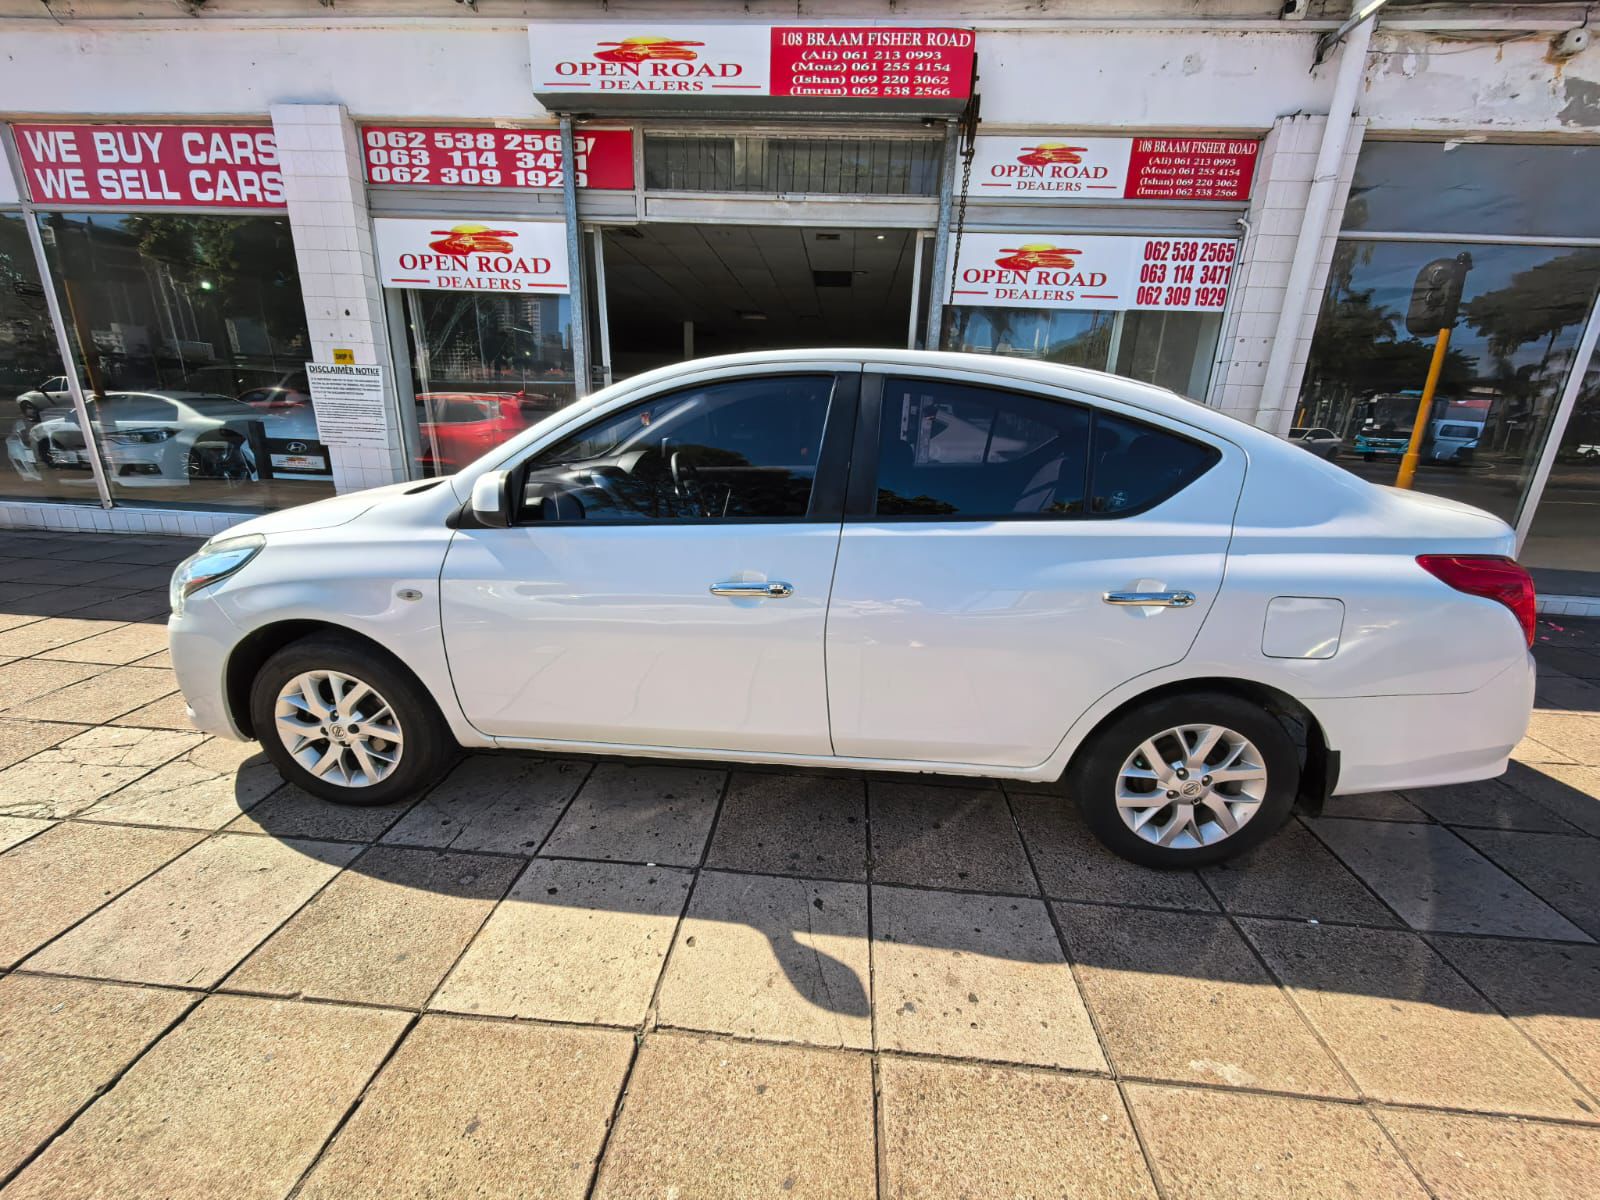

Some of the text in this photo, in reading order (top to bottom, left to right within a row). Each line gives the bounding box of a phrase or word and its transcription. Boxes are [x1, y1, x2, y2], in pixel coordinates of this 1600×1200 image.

[781, 32, 971, 47] 108 BRAAM FISHER ROAD
[801, 50, 942, 61] (Ali) 061 213 0993
[555, 62, 742, 77] OPEN ROAD
[791, 62, 951, 72] (Moaz) 061 255 4154
[600, 79, 704, 91] DEALERS
[792, 75, 949, 85] (Ishan) 069 220 3062
[790, 86, 951, 97] (Imran) 062 538 2566
[366, 131, 426, 149] 062
[434, 133, 495, 150] 538
[1138, 140, 1257, 155] 108 BRAAM FISHER ROAD
[24, 131, 280, 166] WE BUY CARS
[369, 149, 430, 166] 063
[448, 151, 498, 168] 114
[1149, 157, 1172, 166] (Ali)
[1193, 158, 1211, 166] 213
[1213, 159, 1236, 167] 0993
[371, 167, 588, 187] 062 309 1929
[991, 164, 1109, 180] OPEN ROAD
[1198, 168, 1215, 176] 255
[1217, 168, 1240, 176] 4154
[33, 168, 287, 203] WE SELL CARS
[1017, 181, 1082, 192] DEALERS
[1175, 188, 1192, 196] 062
[1195, 188, 1212, 196] 538
[1144, 240, 1236, 263] 062 538 2565
[399, 253, 551, 275] OPEN ROAD
[963, 268, 1107, 287] OPEN ROAD
[1140, 263, 1231, 285] 063 114 3471
[437, 276, 522, 291] DEALERS
[995, 288, 1075, 301] DEALERS
[1136, 285, 1227, 307] 062 309 1929
[309, 365, 380, 377] DISCLAIMER NOTICE
